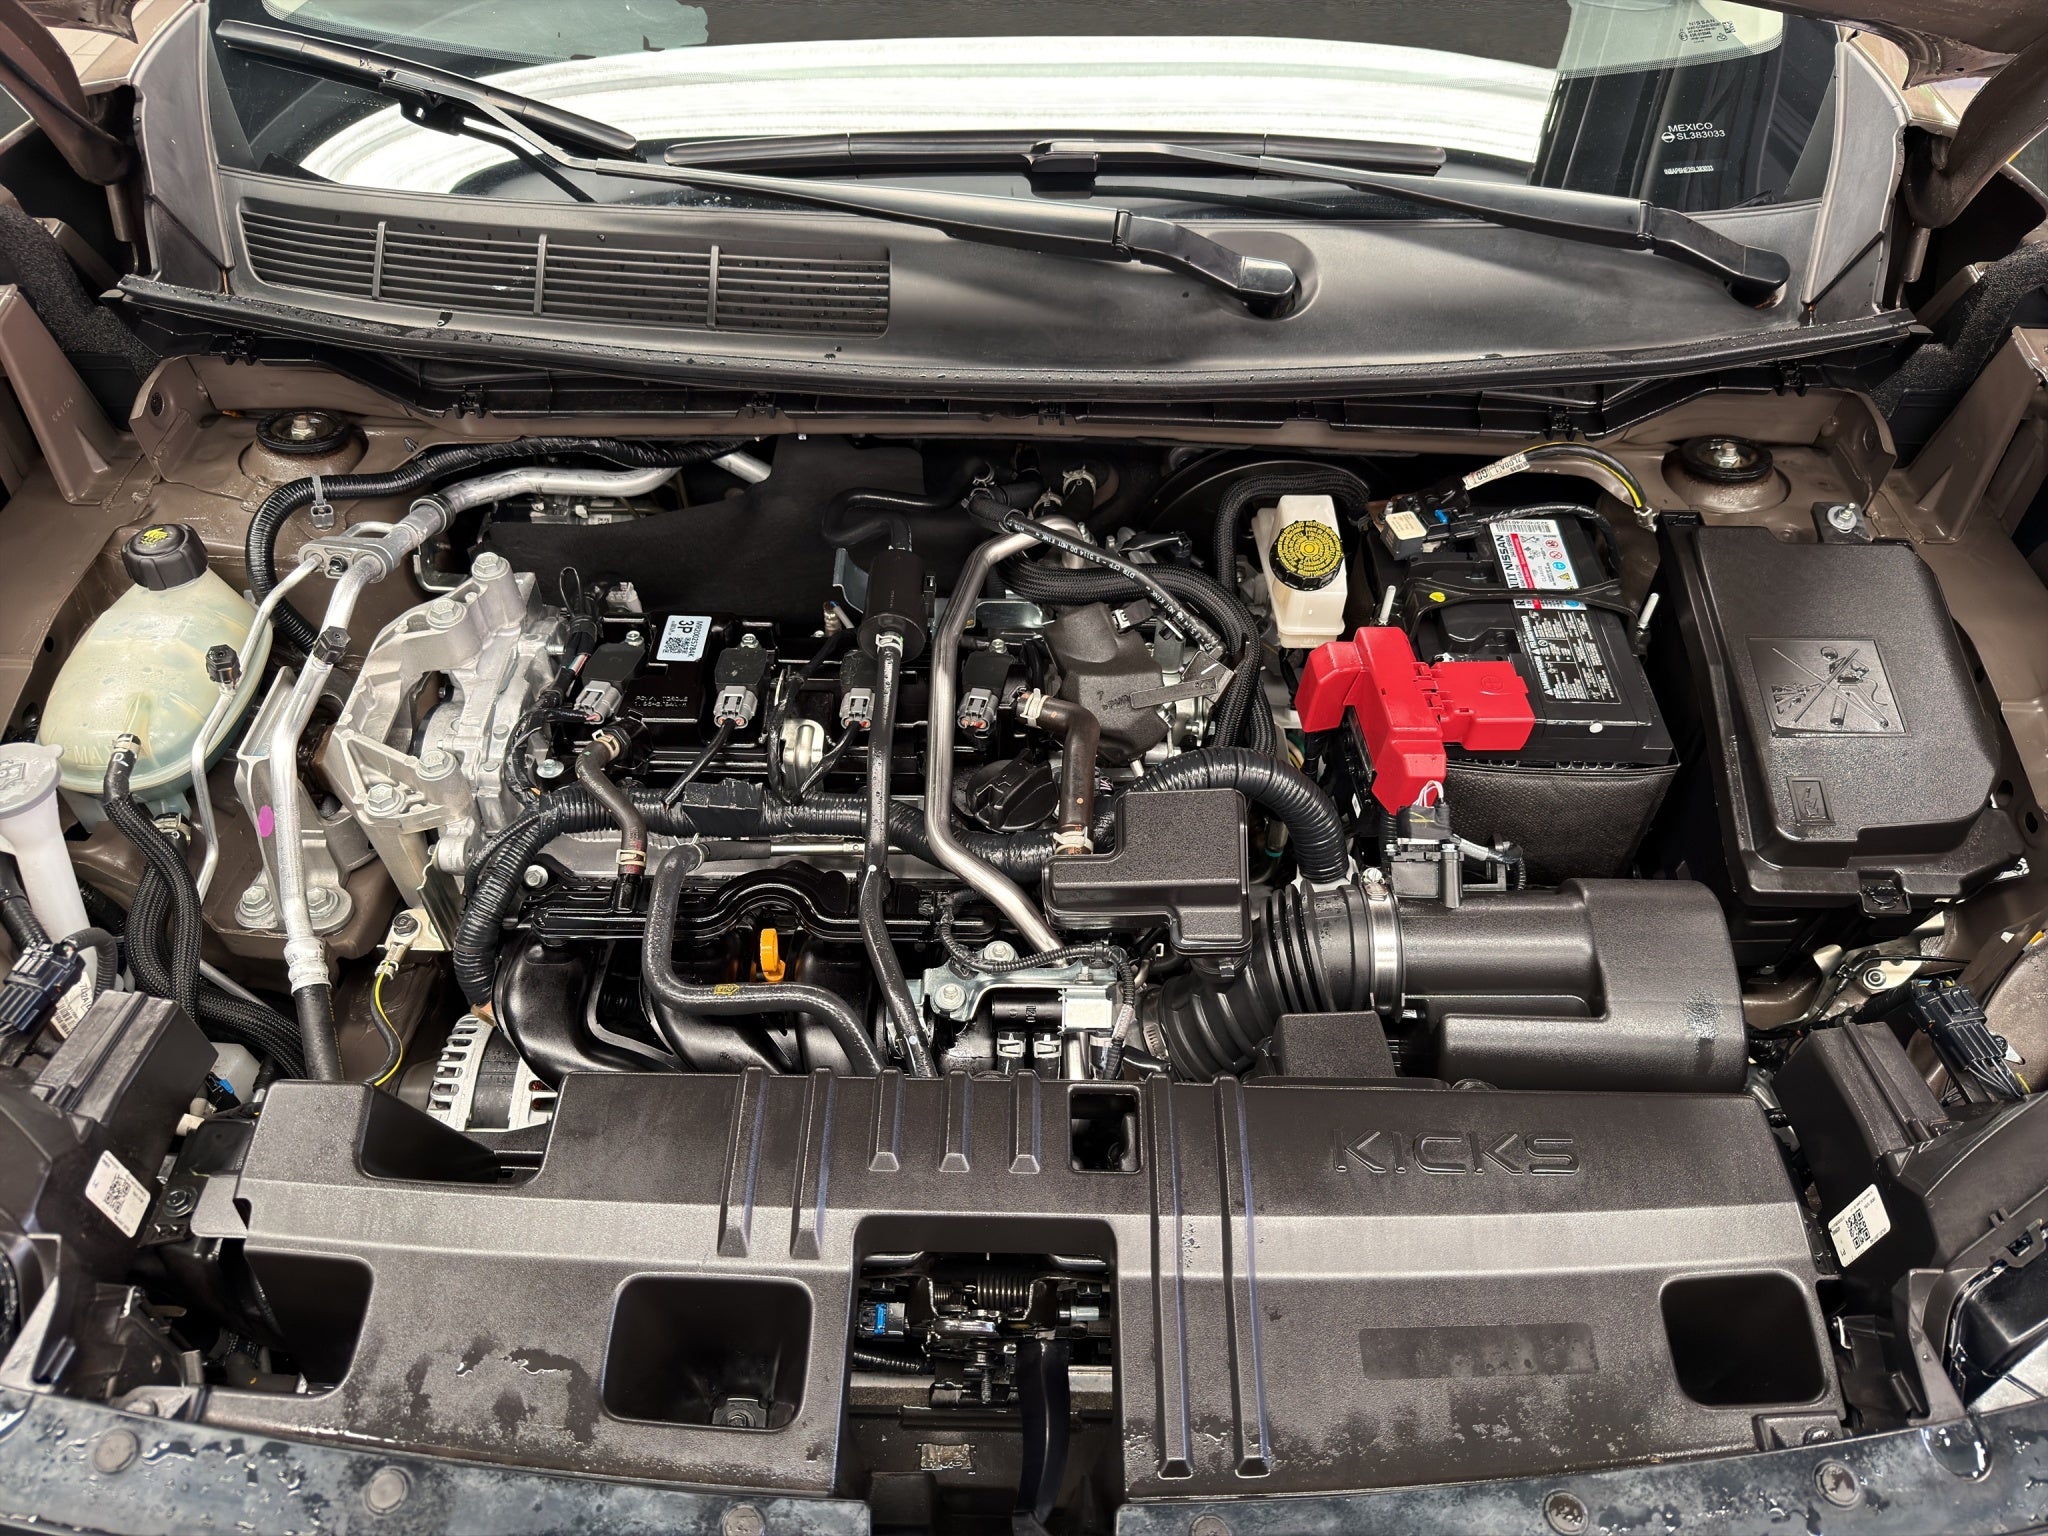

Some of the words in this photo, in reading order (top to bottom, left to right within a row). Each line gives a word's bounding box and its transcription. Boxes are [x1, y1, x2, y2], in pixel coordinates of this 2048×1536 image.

[1668, 122, 1713, 133] MEXICO
[1676, 129, 1726, 141] SL383033
[1039, 533, 1056, 544] KINK
[1056, 539, 1069, 550] NOT
[1495, 534, 1514, 571] NISSAN
[1149, 588, 1166, 605] KINK
[677, 620, 695, 634] 3P
[1333, 1129, 1580, 1176] KICKS
